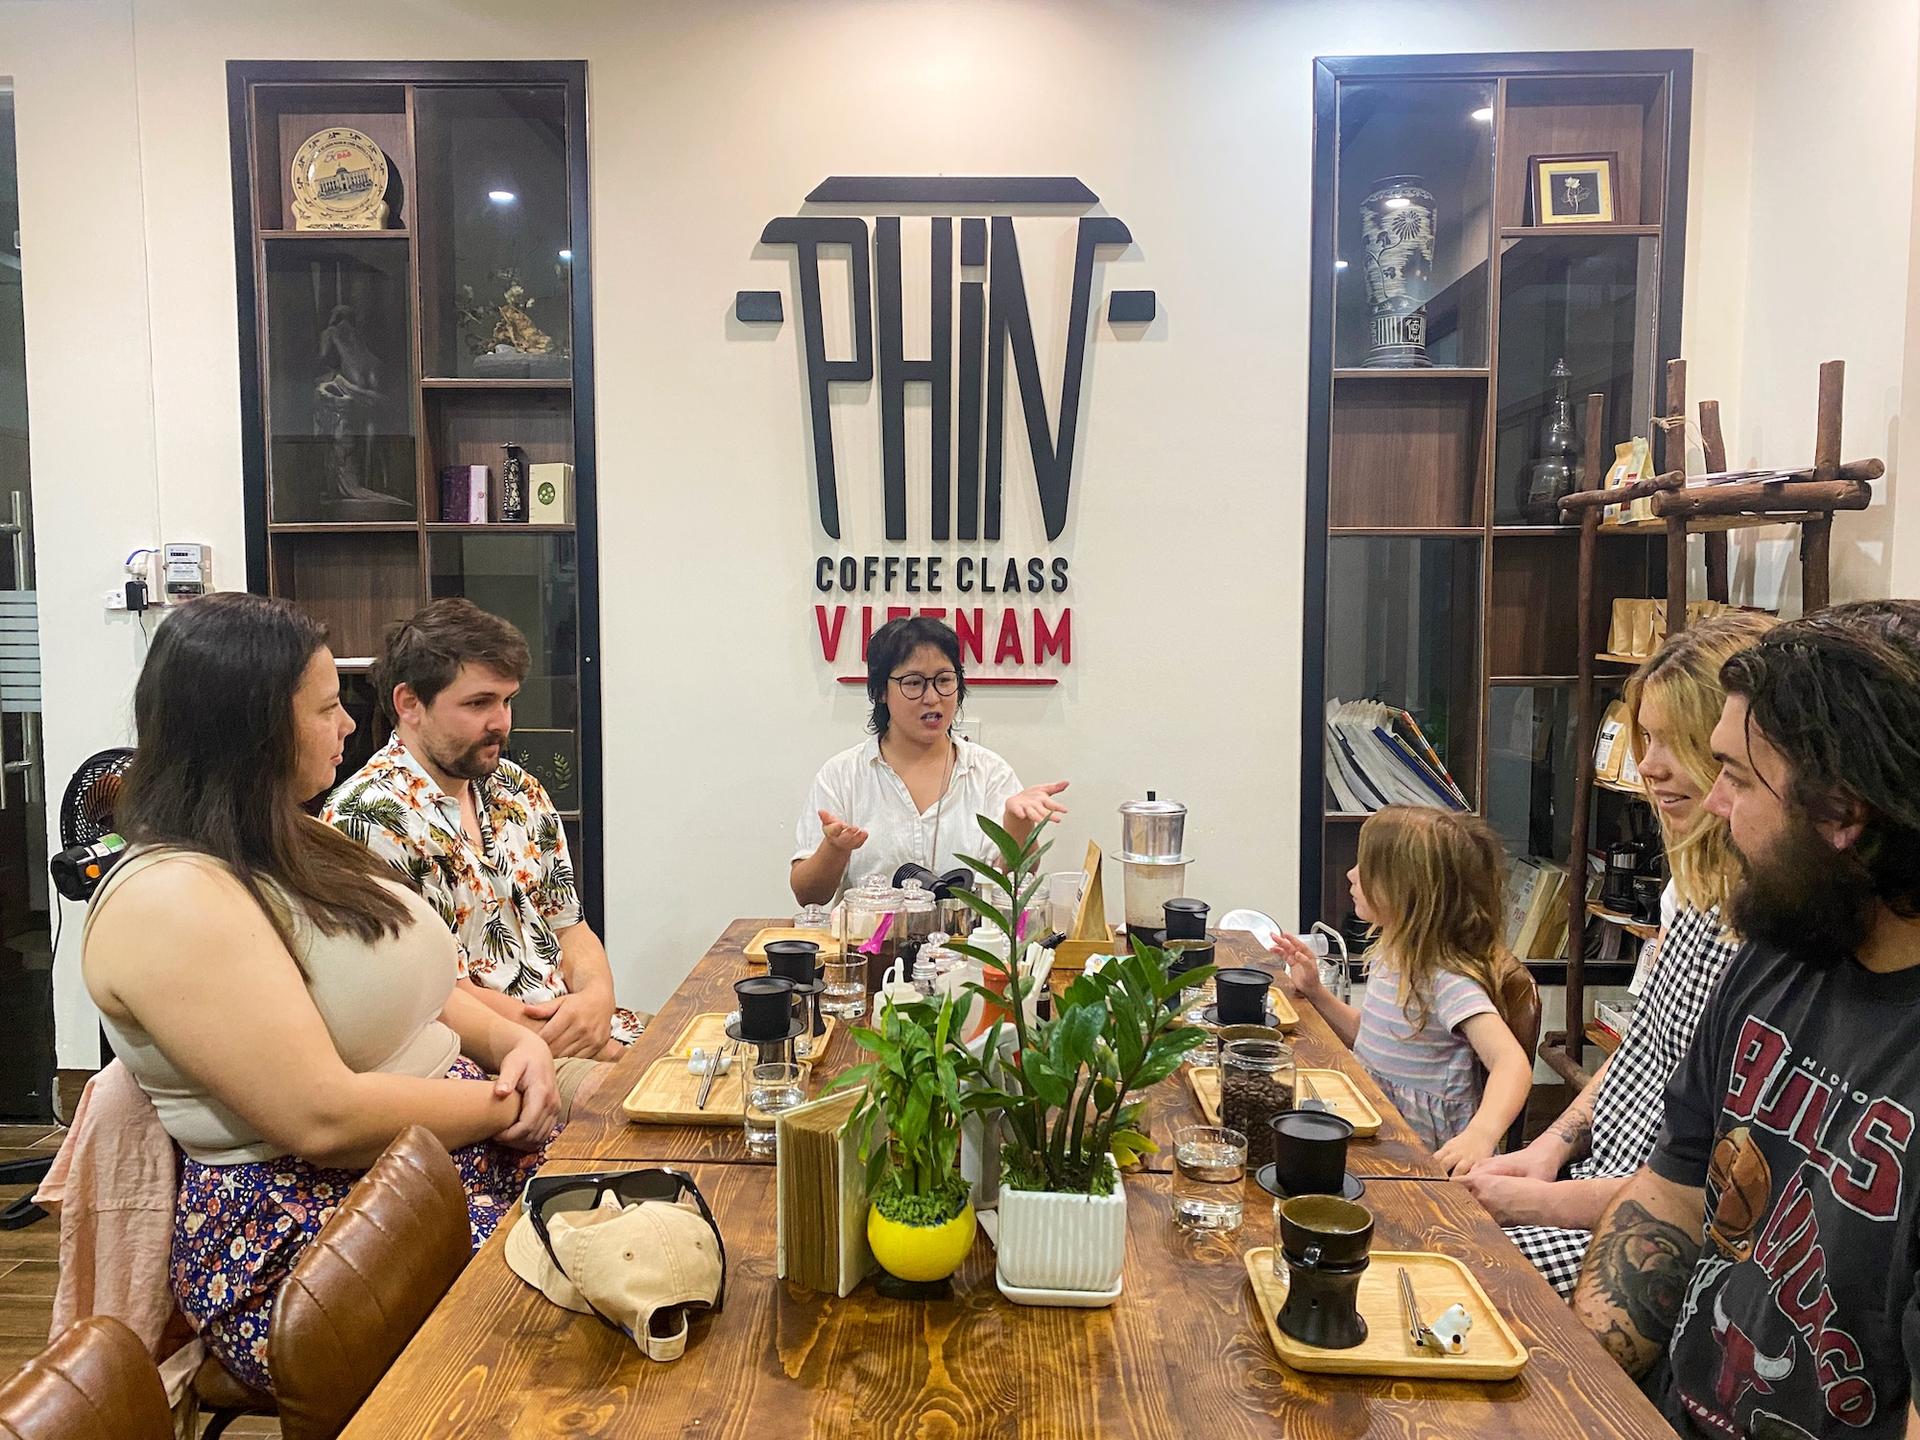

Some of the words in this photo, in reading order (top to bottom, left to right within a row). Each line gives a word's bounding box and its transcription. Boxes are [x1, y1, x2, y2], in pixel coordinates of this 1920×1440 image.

[816, 556, 943, 593] COFFEE
[956, 556, 1070, 593] CLASS
[815, 605, 1072, 665] VINAM
[1722, 1014, 1916, 1222] BULLS
